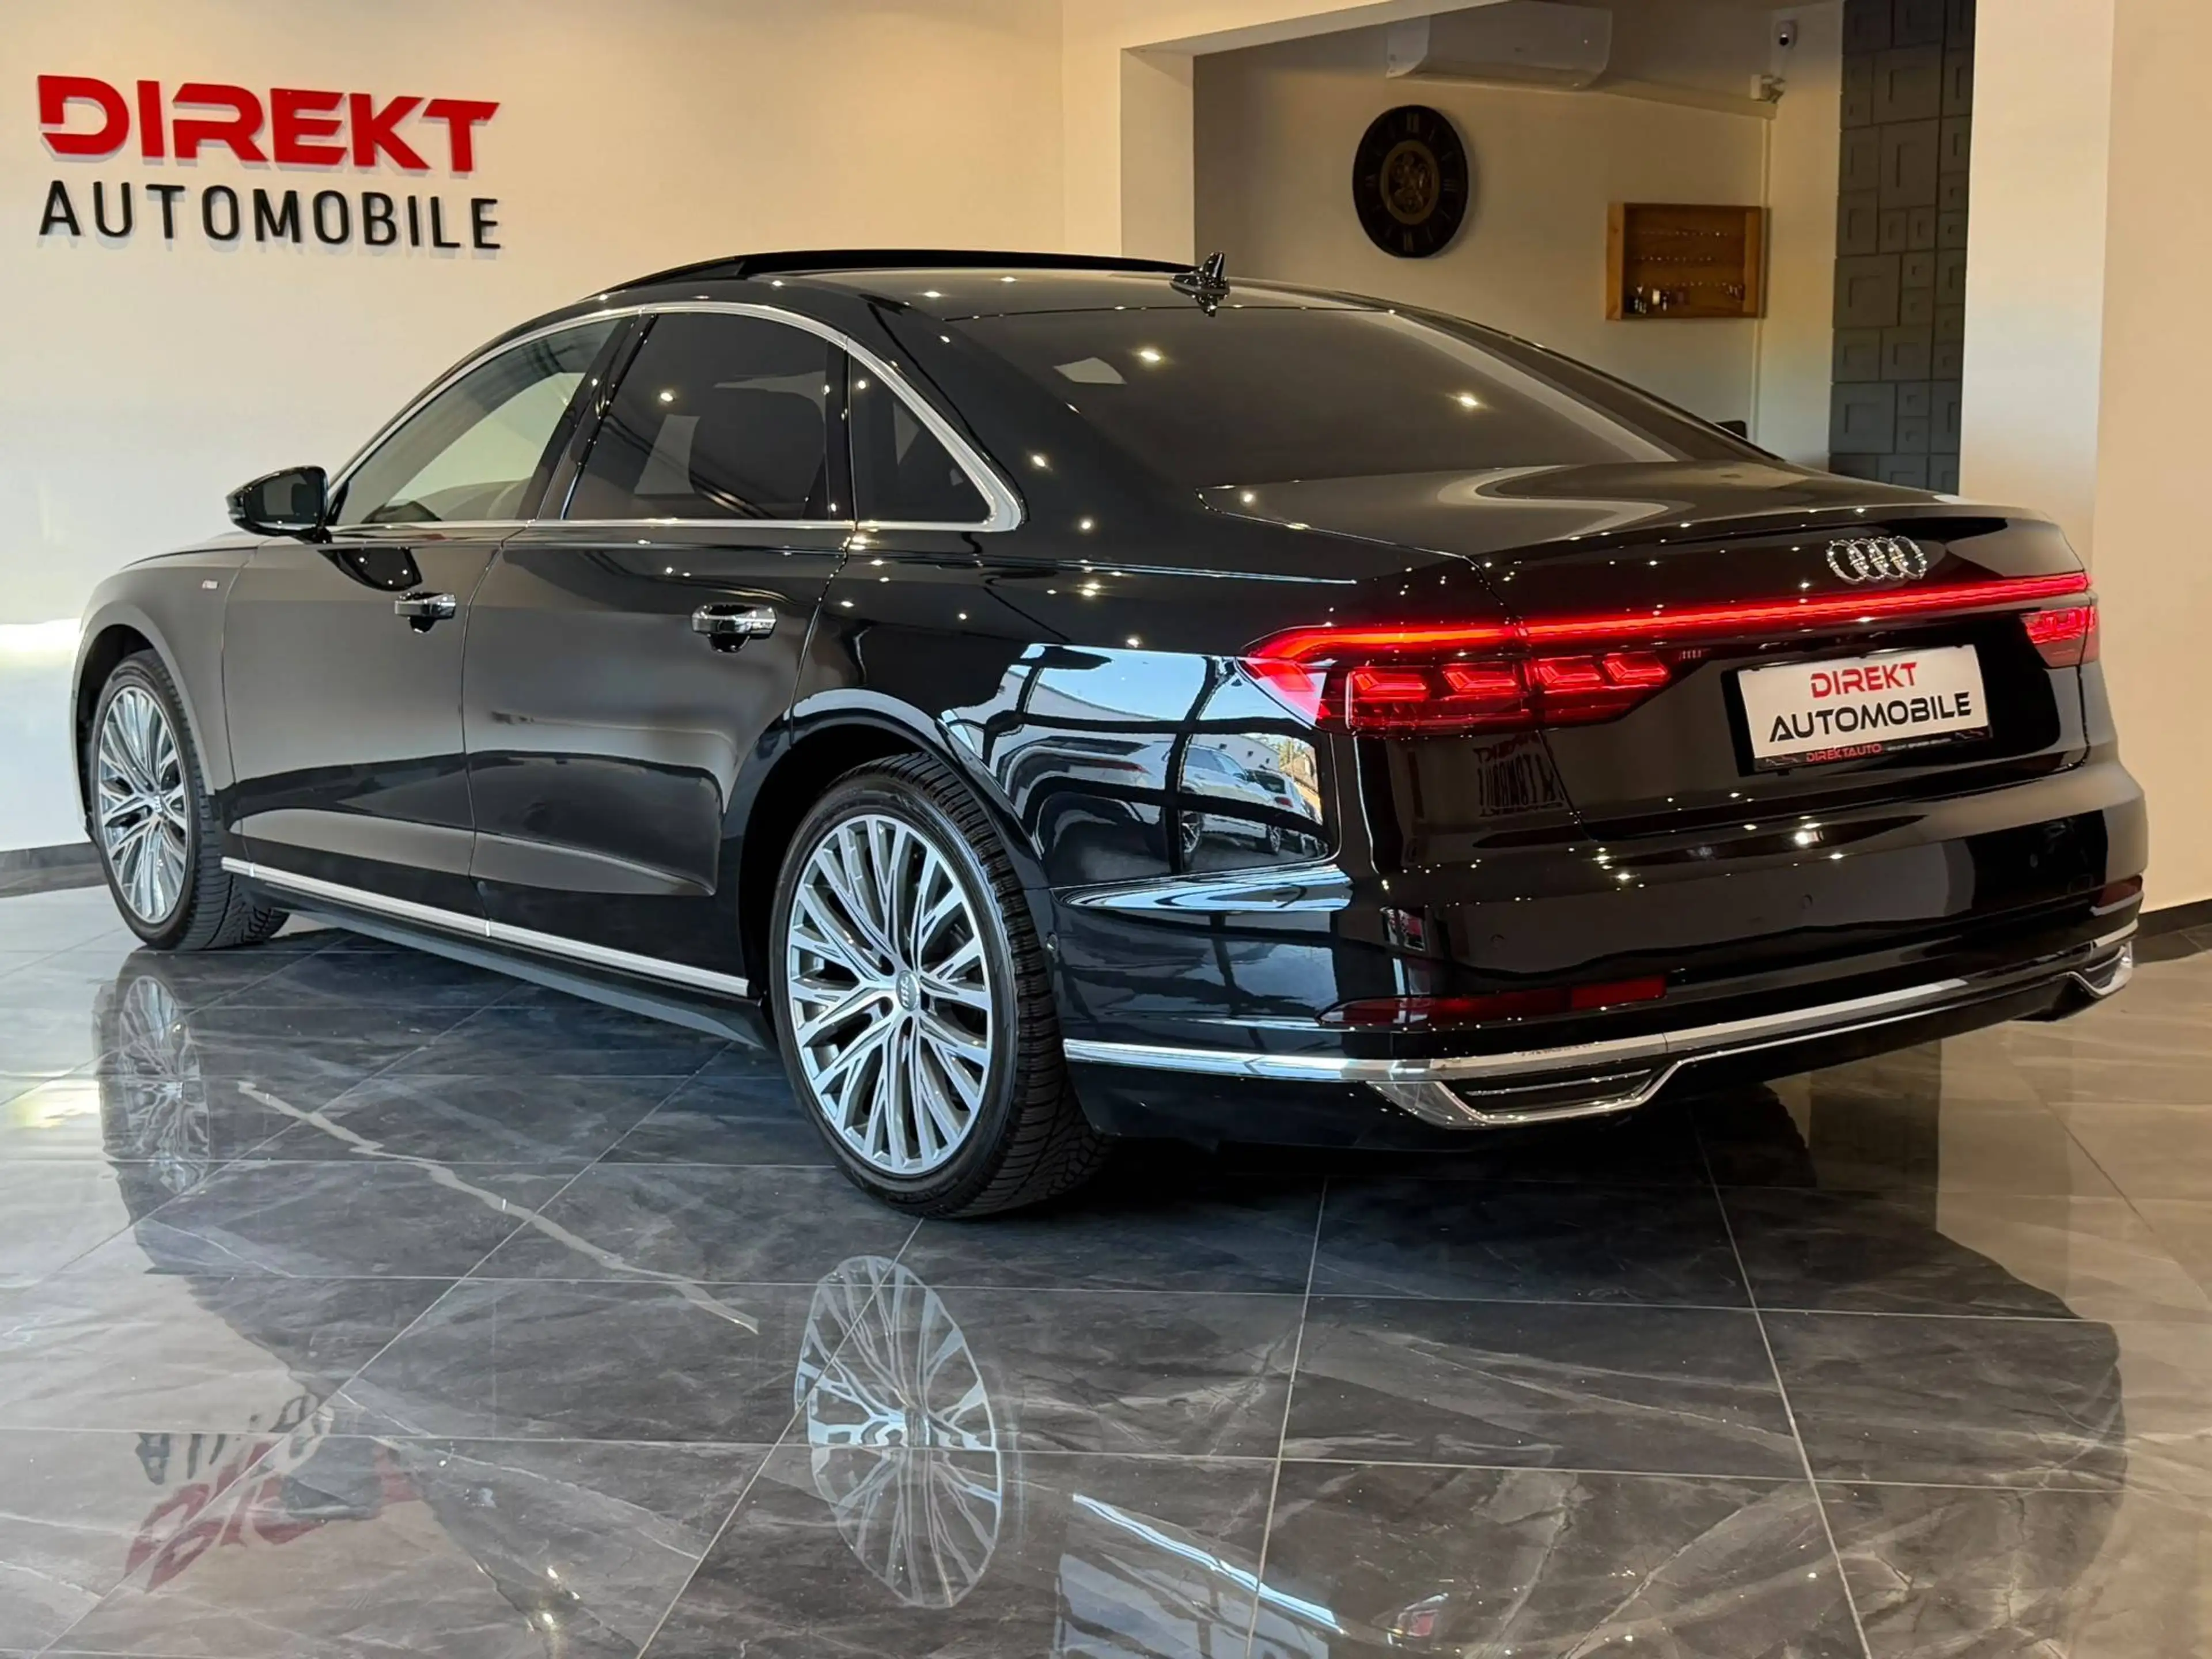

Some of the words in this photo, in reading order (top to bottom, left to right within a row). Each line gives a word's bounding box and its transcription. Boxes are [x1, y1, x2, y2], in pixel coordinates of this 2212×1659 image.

[37, 75, 501, 172] DIREKT
[39, 180, 501, 248] AUTOMOBILE
[1811, 662, 1917, 698] DIREKT
[1770, 692, 1971, 742] AUTOMOBILE
[1806, 743, 1883, 763] DIREKTAUTO
